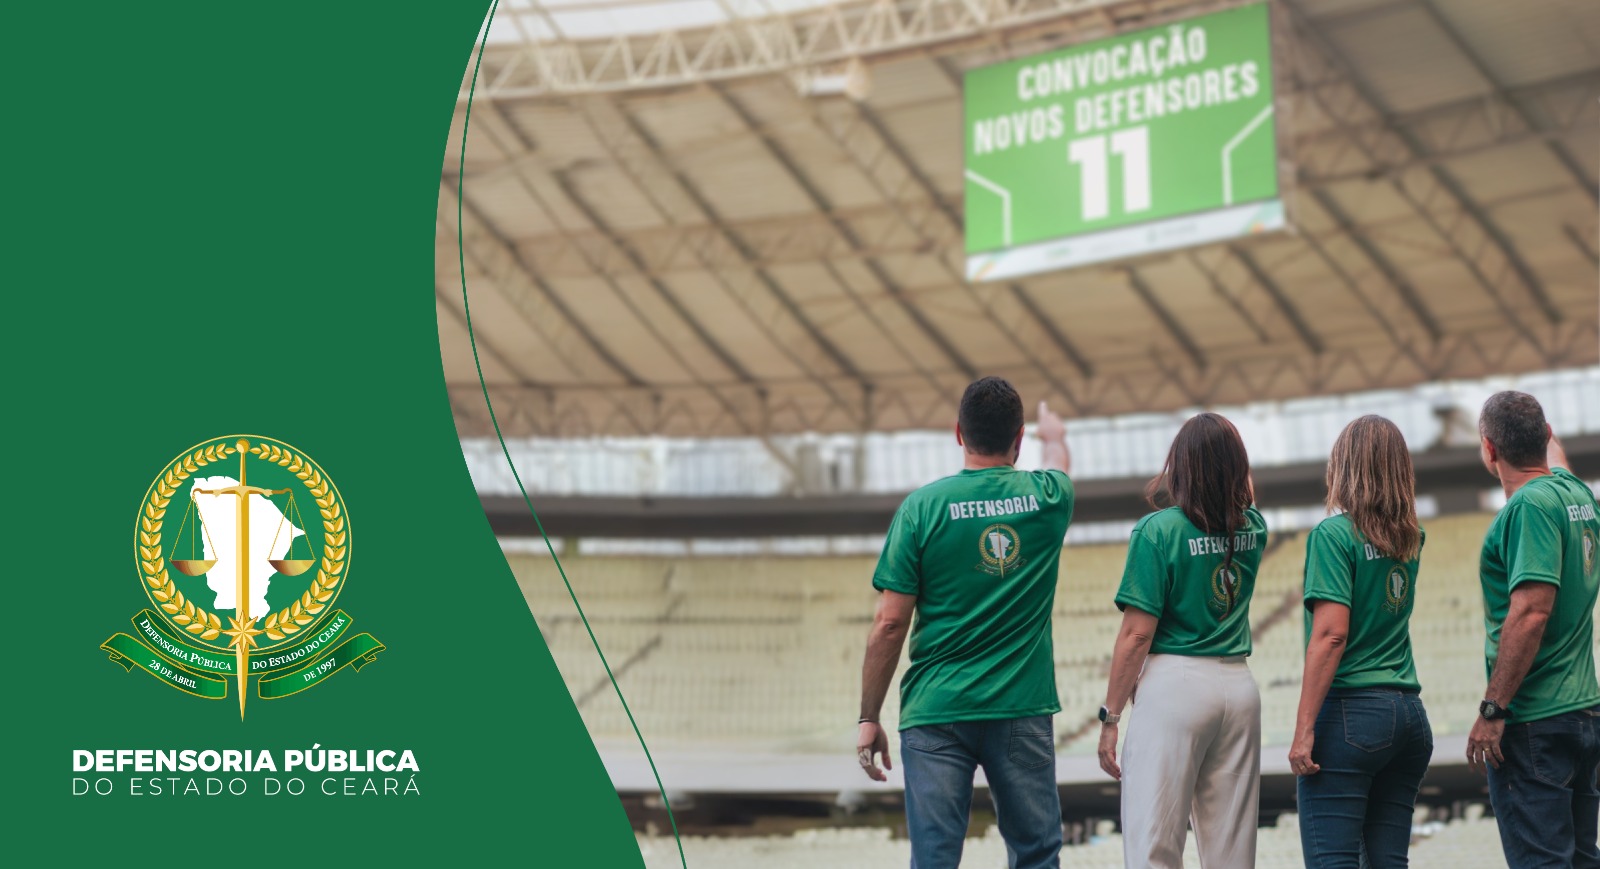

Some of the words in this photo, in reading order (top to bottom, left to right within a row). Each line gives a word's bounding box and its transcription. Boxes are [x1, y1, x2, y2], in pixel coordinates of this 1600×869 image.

[1017, 24, 1207, 101] CONVOCAÇÃO
[973, 103, 1065, 155] NOVOS
[1074, 61, 1260, 134] DEFENSORES
[1067, 124, 1151, 222] 11
[949, 494, 1040, 520] DEFENSORIA
